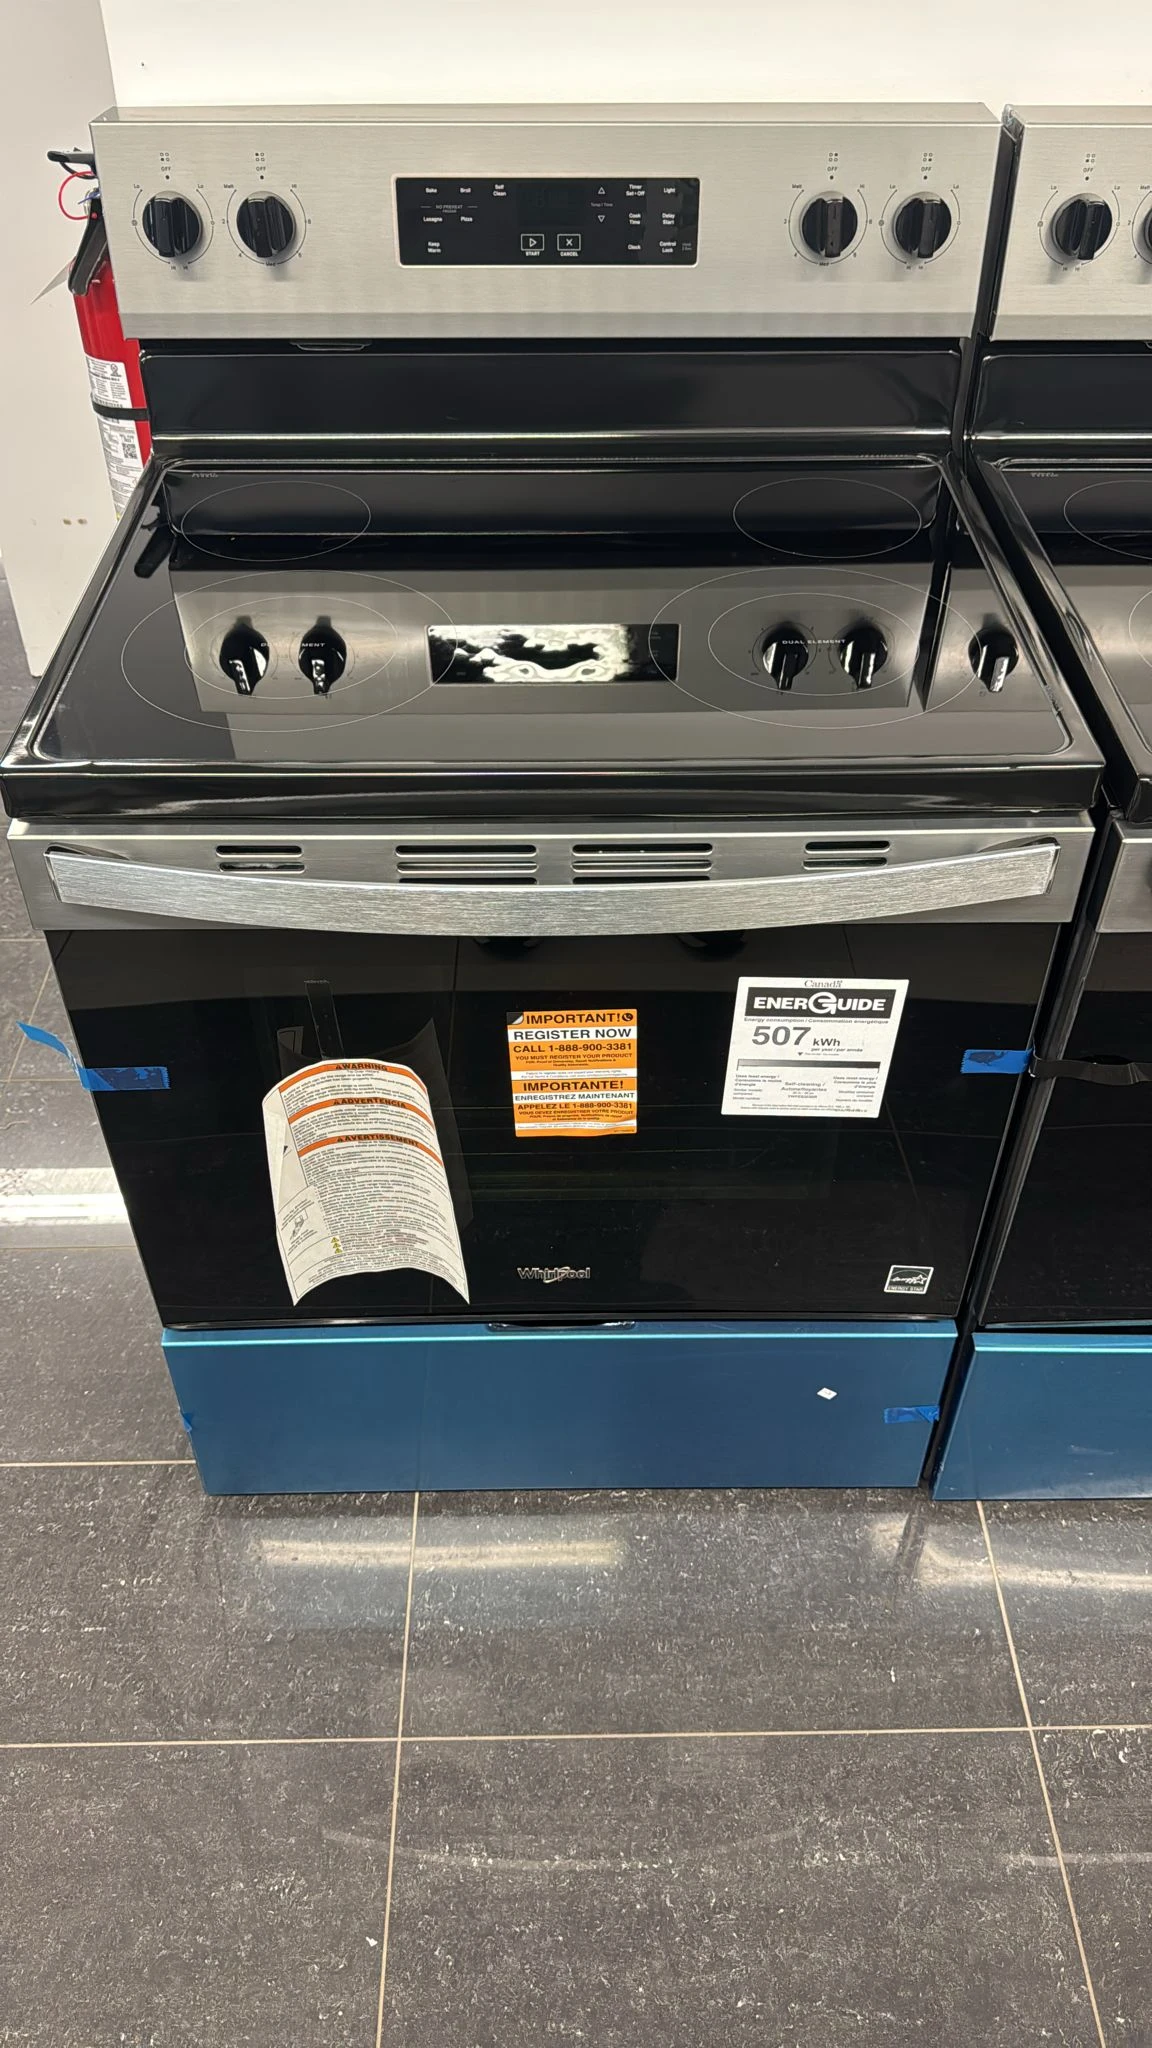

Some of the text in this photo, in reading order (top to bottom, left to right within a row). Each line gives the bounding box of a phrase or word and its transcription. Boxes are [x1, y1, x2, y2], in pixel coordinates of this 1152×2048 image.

[804, 980, 843, 988] Canada
[753, 991, 887, 1015] ENERGUIDE
[526, 1013, 620, 1024] IMPORTANT!
[513, 1028, 632, 1040] REGISTER NOW
[752, 1026, 841, 1046] 507 kWh
[513, 1042, 632, 1053] CALL 1-888-900-3381
[343, 1063, 387, 1071] WARNING
[523, 1080, 623, 1091] IMPORTANTE!
[515, 1092, 635, 1101] ENREGISTREZ MAINTENANT
[341, 1097, 406, 1109] ADVERTENCIA
[344, 1134, 420, 1148] AVERTISSEMENT
[516, 1266, 591, 1283] Whirlpool
